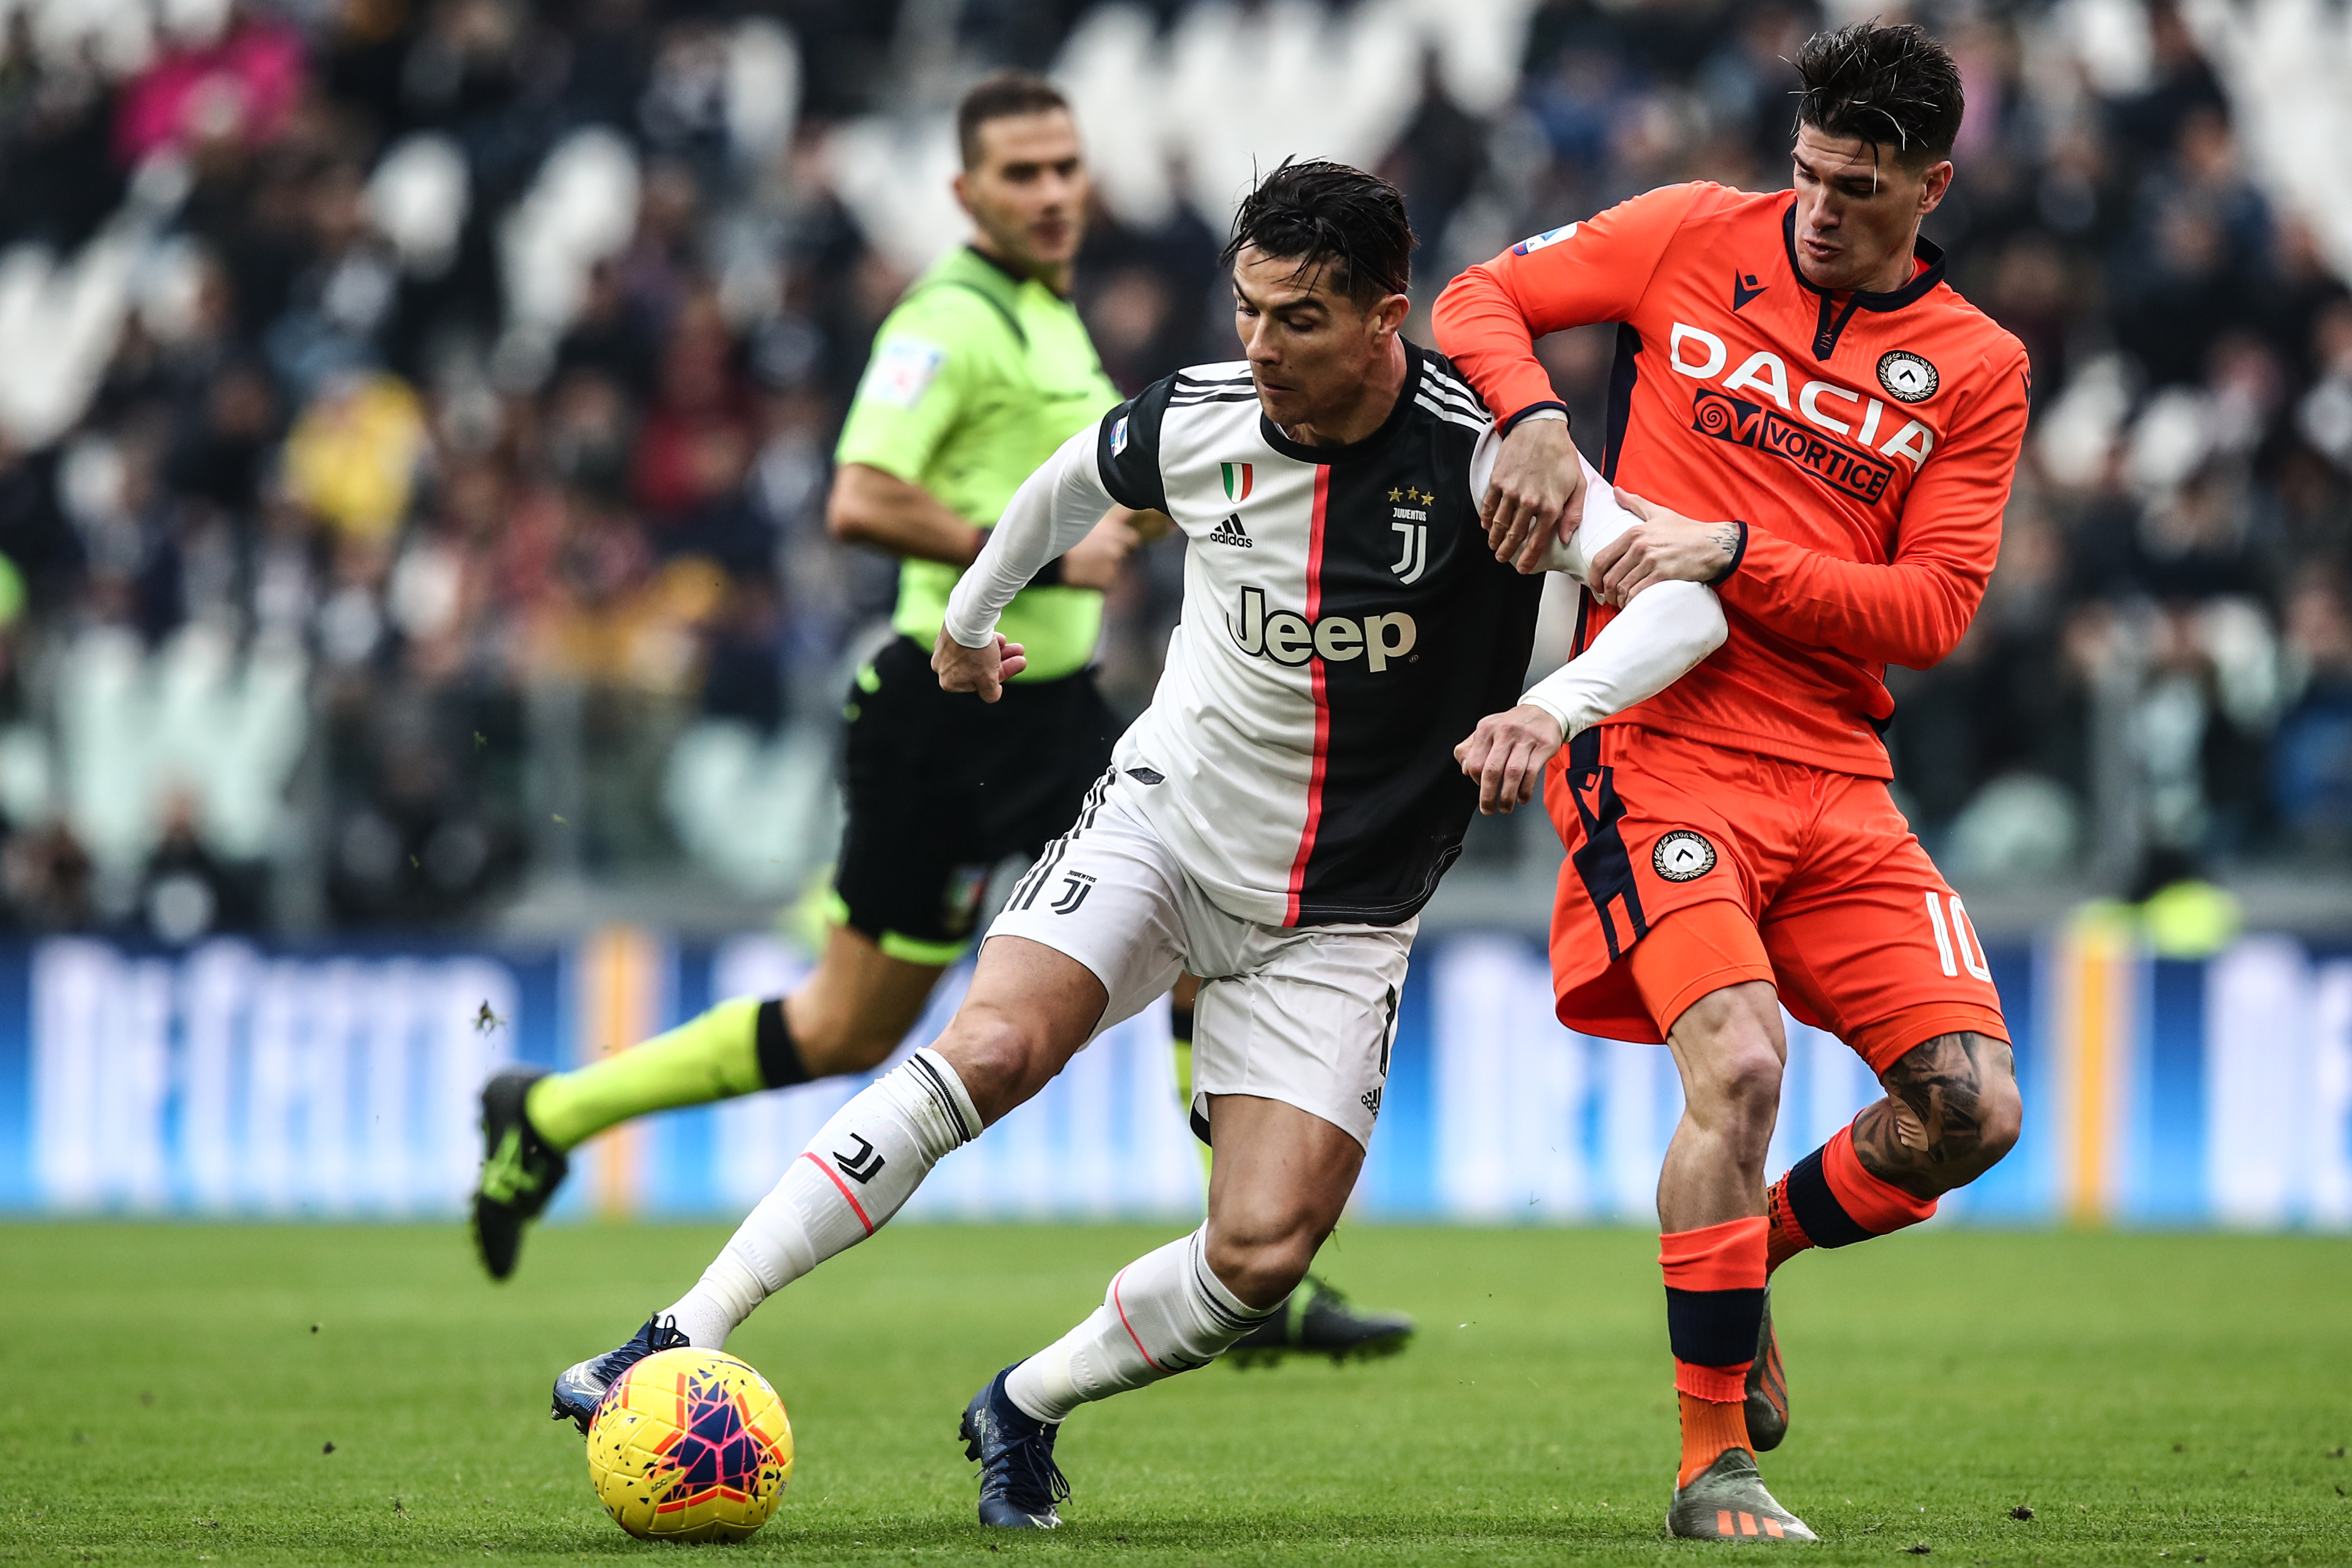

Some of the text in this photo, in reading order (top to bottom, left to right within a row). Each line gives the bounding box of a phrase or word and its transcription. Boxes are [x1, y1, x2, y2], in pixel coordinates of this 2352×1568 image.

[1902, 353, 1919, 362] 1896
[1670, 322, 1934, 473] DACIA
[1770, 421, 1888, 497] VORTICE
[1393, 507, 1426, 521] JUVENTUS
[1210, 532, 1253, 548] adidas
[1226, 586, 1417, 673] Jeep
[1669, 832, 1689, 841] 1896
[1067, 870, 1097, 883] JUVENTUS
[1925, 892, 1991, 983] 10
